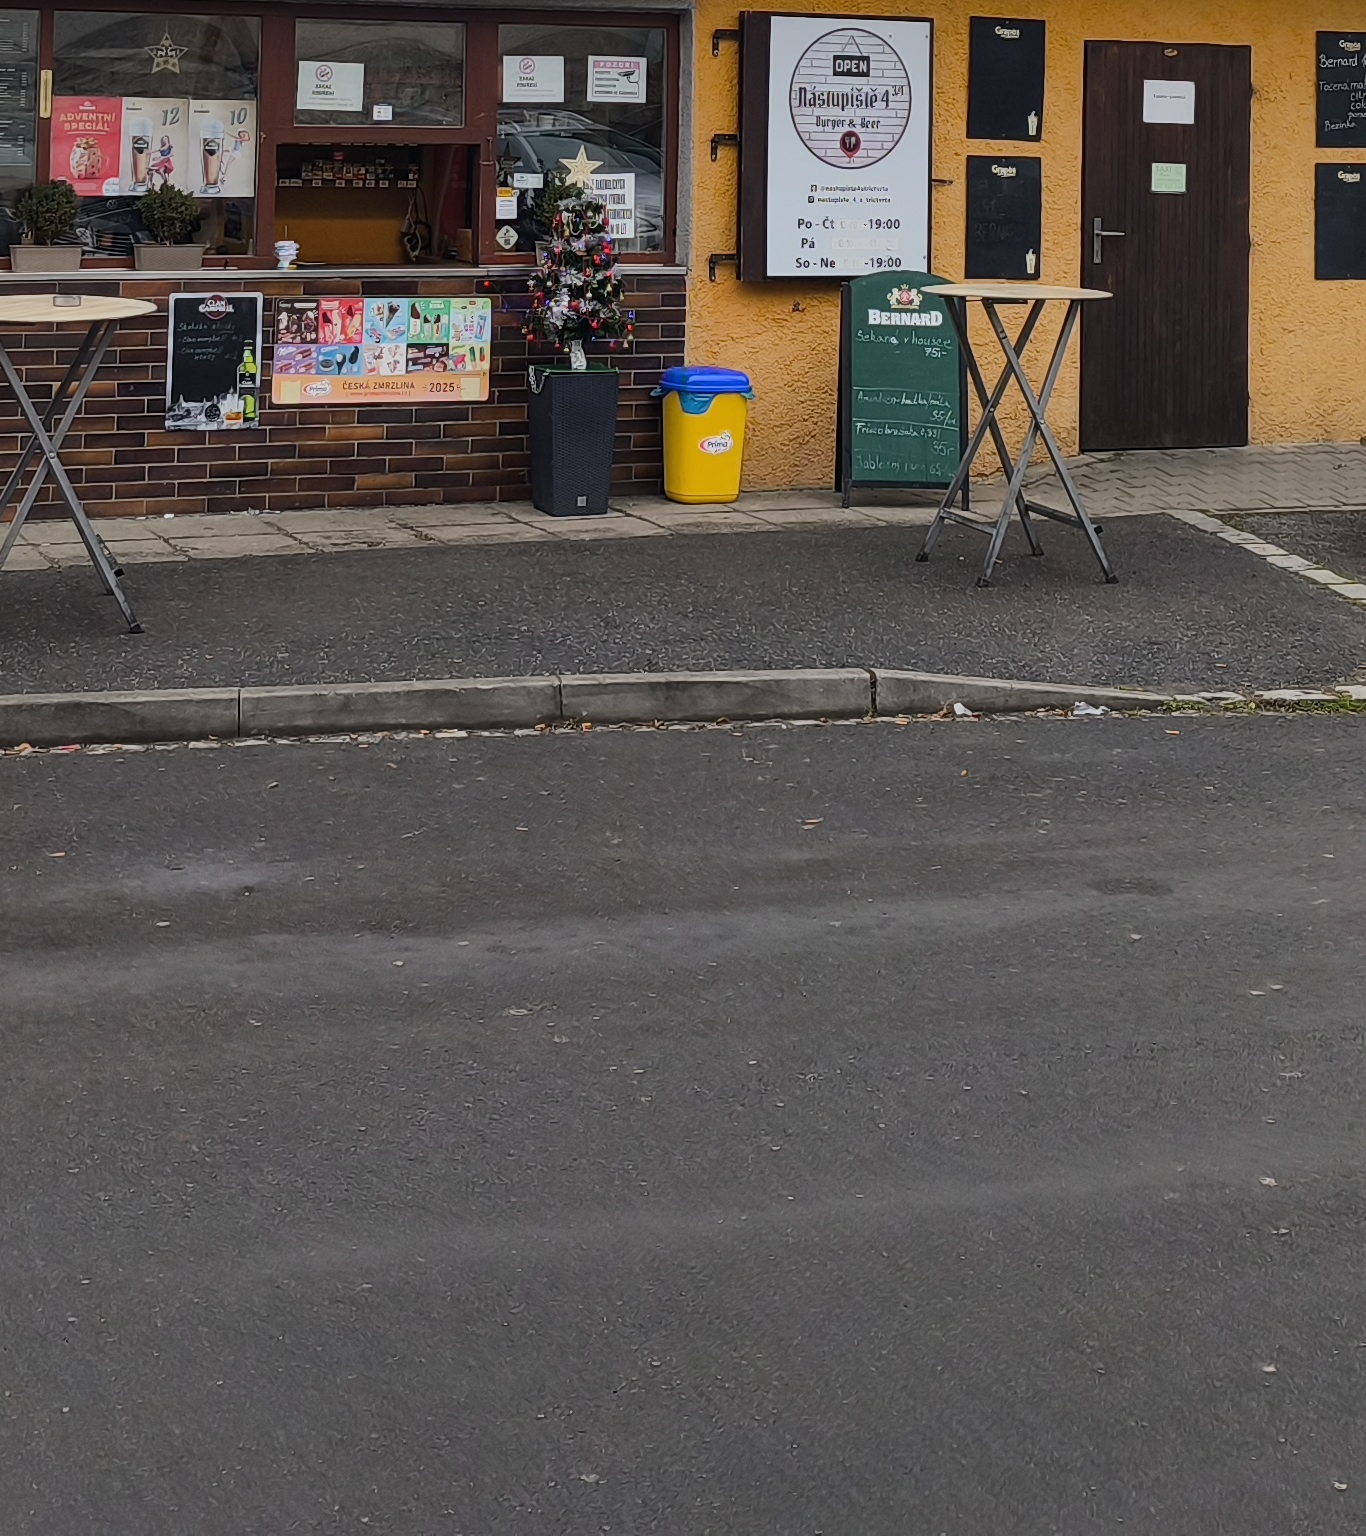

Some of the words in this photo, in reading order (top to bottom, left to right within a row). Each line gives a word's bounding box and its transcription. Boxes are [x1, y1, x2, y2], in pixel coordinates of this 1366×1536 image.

[835, 59, 867, 73] OPEN
[1319, 53, 1358, 68] Bernard
[798, 86, 878, 111] Nástupiště
[881, 89, 889, 108] 4
[60, 112, 116, 122] ADVENTNÍ
[162, 107, 180, 126] 12
[231, 108, 248, 125] 10
[816, 115, 846, 130] Burger
[847, 118, 856, 128] &
[860, 117, 881, 129] Beer
[64, 121, 110, 131] SPECIÁL
[797, 218, 813, 229] Po
[822, 216, 835, 230] Čt
[801, 237, 815, 249] Pá
[795, 257, 810, 269] So
[820, 257, 836, 269] Ne
[867, 309, 943, 327] BERNARD
[855, 329, 899, 345] Sekaná
[342, 380, 371, 390] ČESKÁ
[373, 381, 415, 390] ZMRZLINA
[429, 382, 455, 393] 2025
[707, 439, 728, 449] Prima
